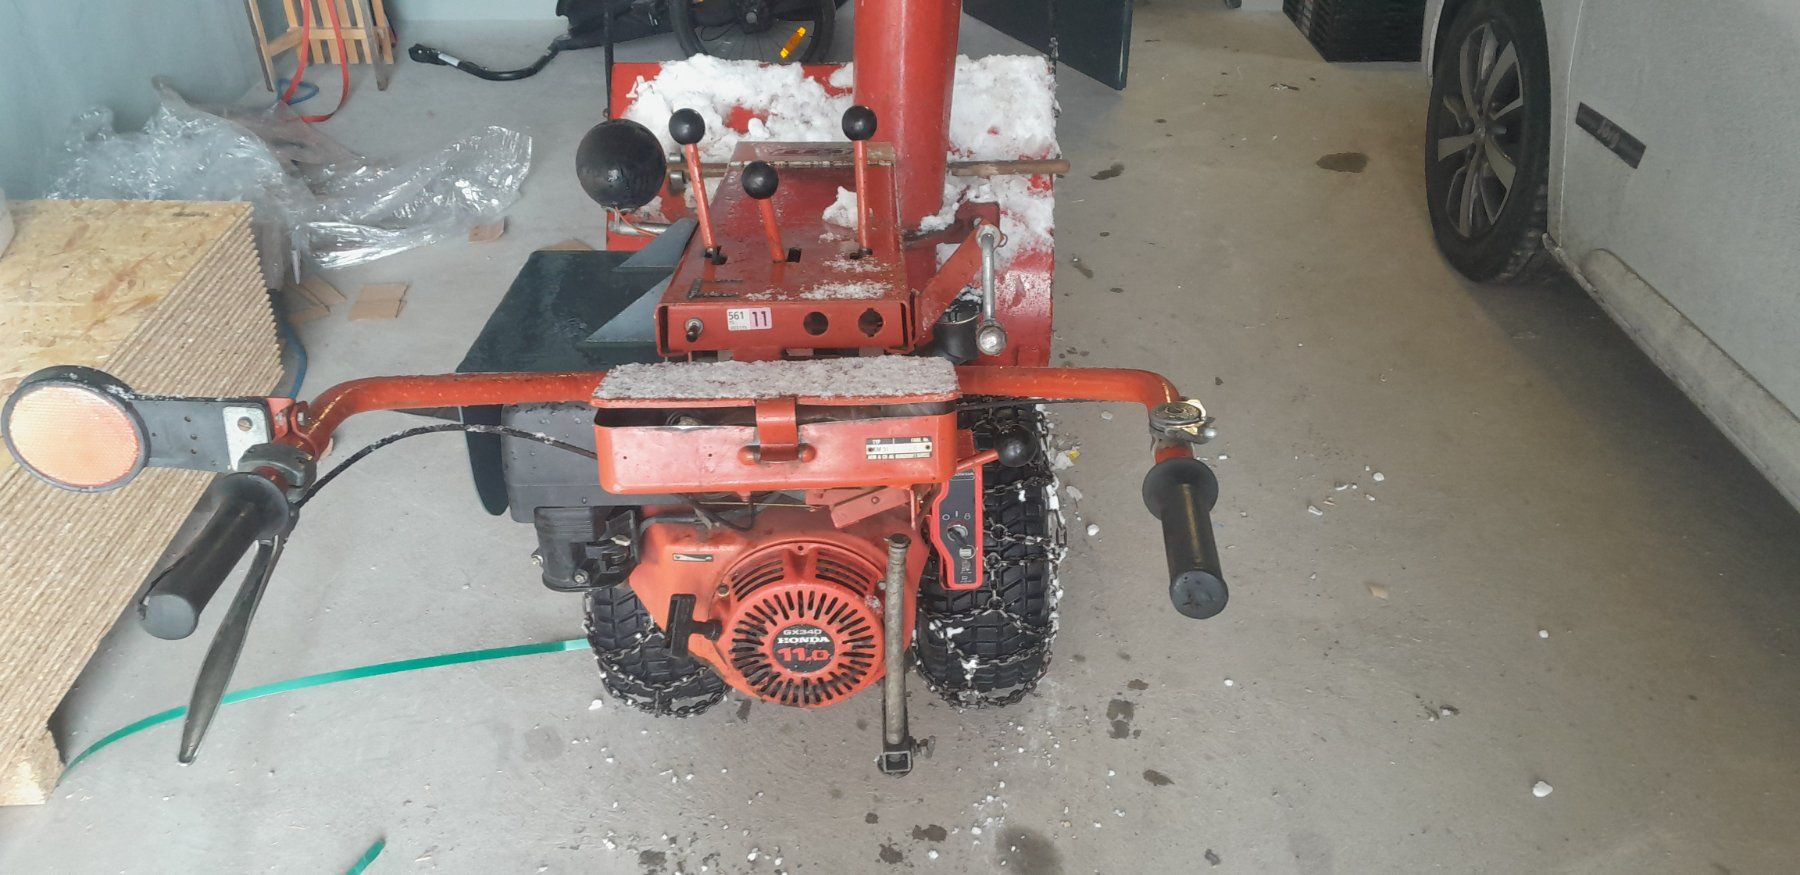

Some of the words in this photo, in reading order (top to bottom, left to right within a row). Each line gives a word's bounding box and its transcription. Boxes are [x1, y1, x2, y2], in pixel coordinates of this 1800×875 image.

[728, 311, 744, 320] 561
[752, 311, 767, 327] 11
[777, 647, 831, 662] 11.0
